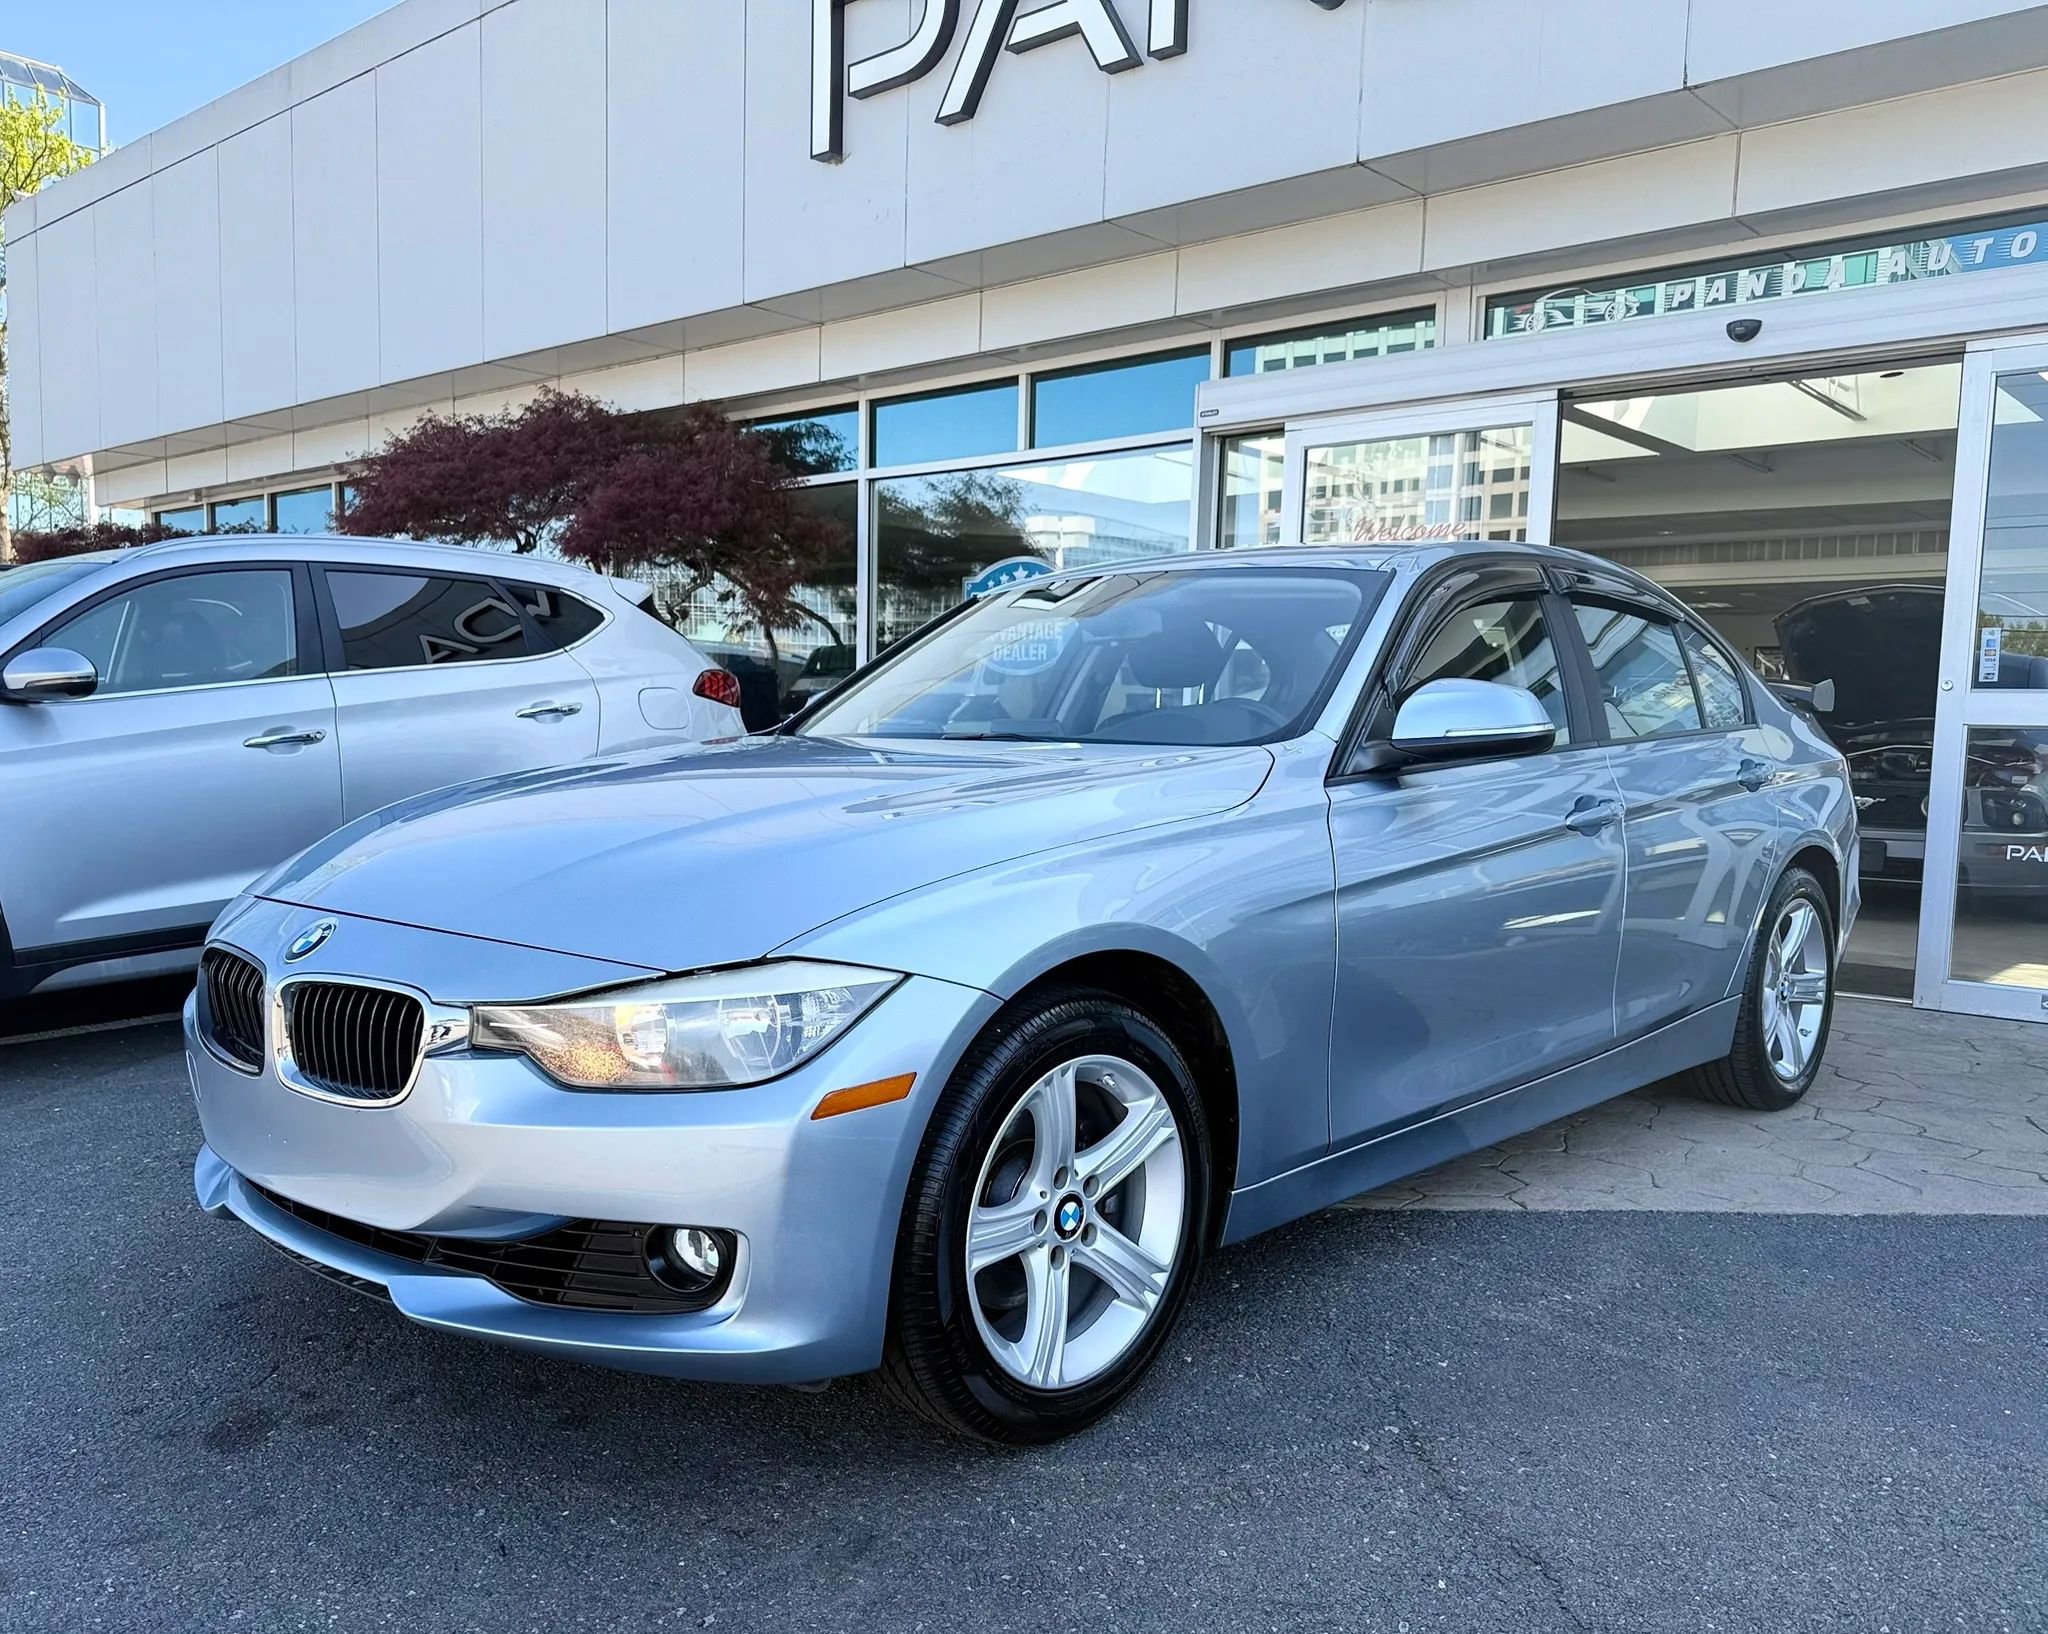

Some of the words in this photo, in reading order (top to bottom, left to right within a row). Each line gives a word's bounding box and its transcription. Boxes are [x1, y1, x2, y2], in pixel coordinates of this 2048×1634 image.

[811, 0, 1341, 163] PA
[1671, 260, 1847, 308] PANDA
[1887, 230, 2038, 277] AUTO
[1354, 514, 1467, 541] Welcome
[993, 643, 1048, 662] DEALER
[2006, 845, 2048, 862] PA
